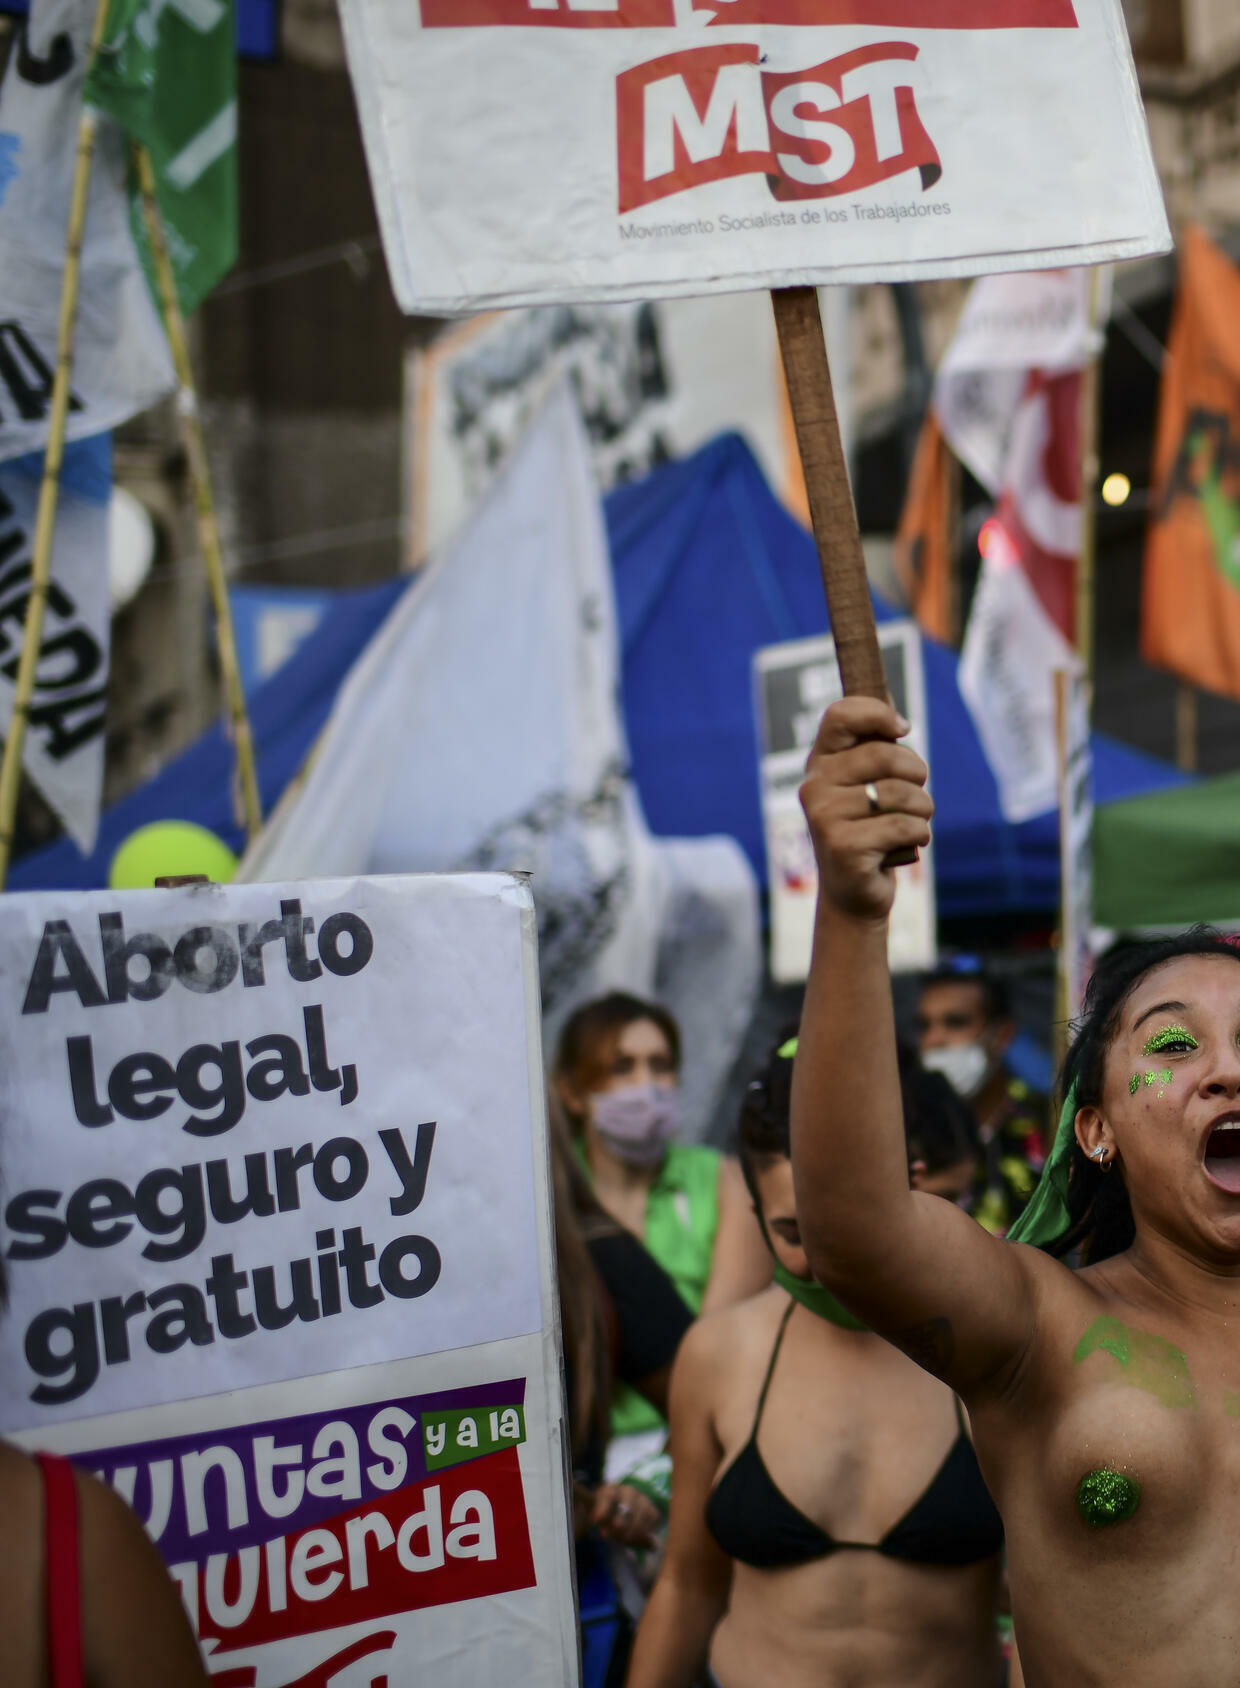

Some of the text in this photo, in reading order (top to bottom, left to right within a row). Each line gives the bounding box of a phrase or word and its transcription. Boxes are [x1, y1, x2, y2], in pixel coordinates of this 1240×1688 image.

[644, 58, 918, 185] MST
[618, 200, 952, 241] Movimiento Socialista de los Trabajadores
[21, 899, 374, 1015] Aborto
[66, 1004, 360, 1137] legal,
[4, 1121, 437, 1262] seguro y
[24, 1226, 442, 1406] gratuito
[96, 1406, 520, 1543] untas y a la
